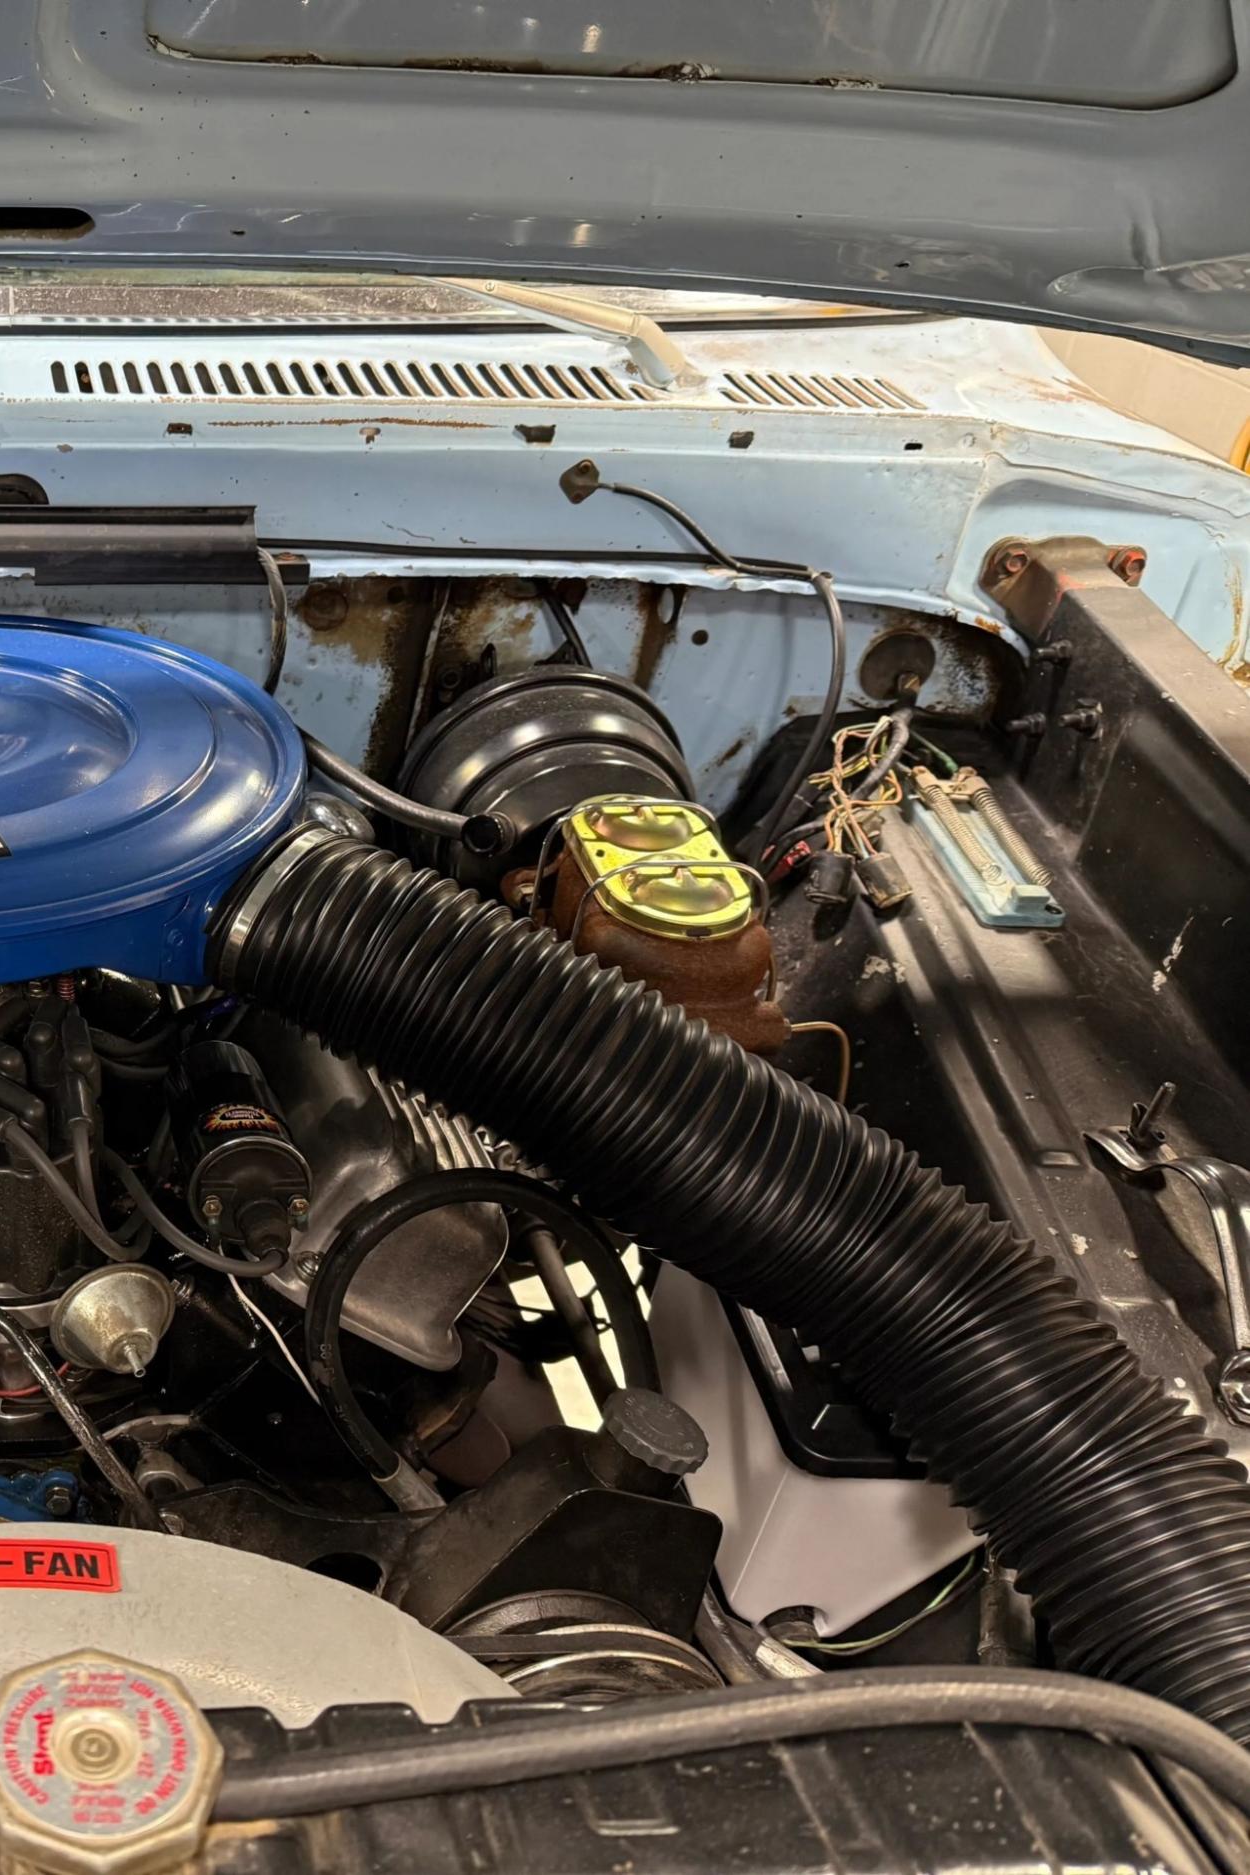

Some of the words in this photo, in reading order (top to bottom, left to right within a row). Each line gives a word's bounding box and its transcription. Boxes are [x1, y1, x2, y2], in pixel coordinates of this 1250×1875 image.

[23, 1551, 100, 1579] FAN
[3, 1684, 47, 1744] PRESSURE
[5, 1750, 48, 1804] CAUTION
